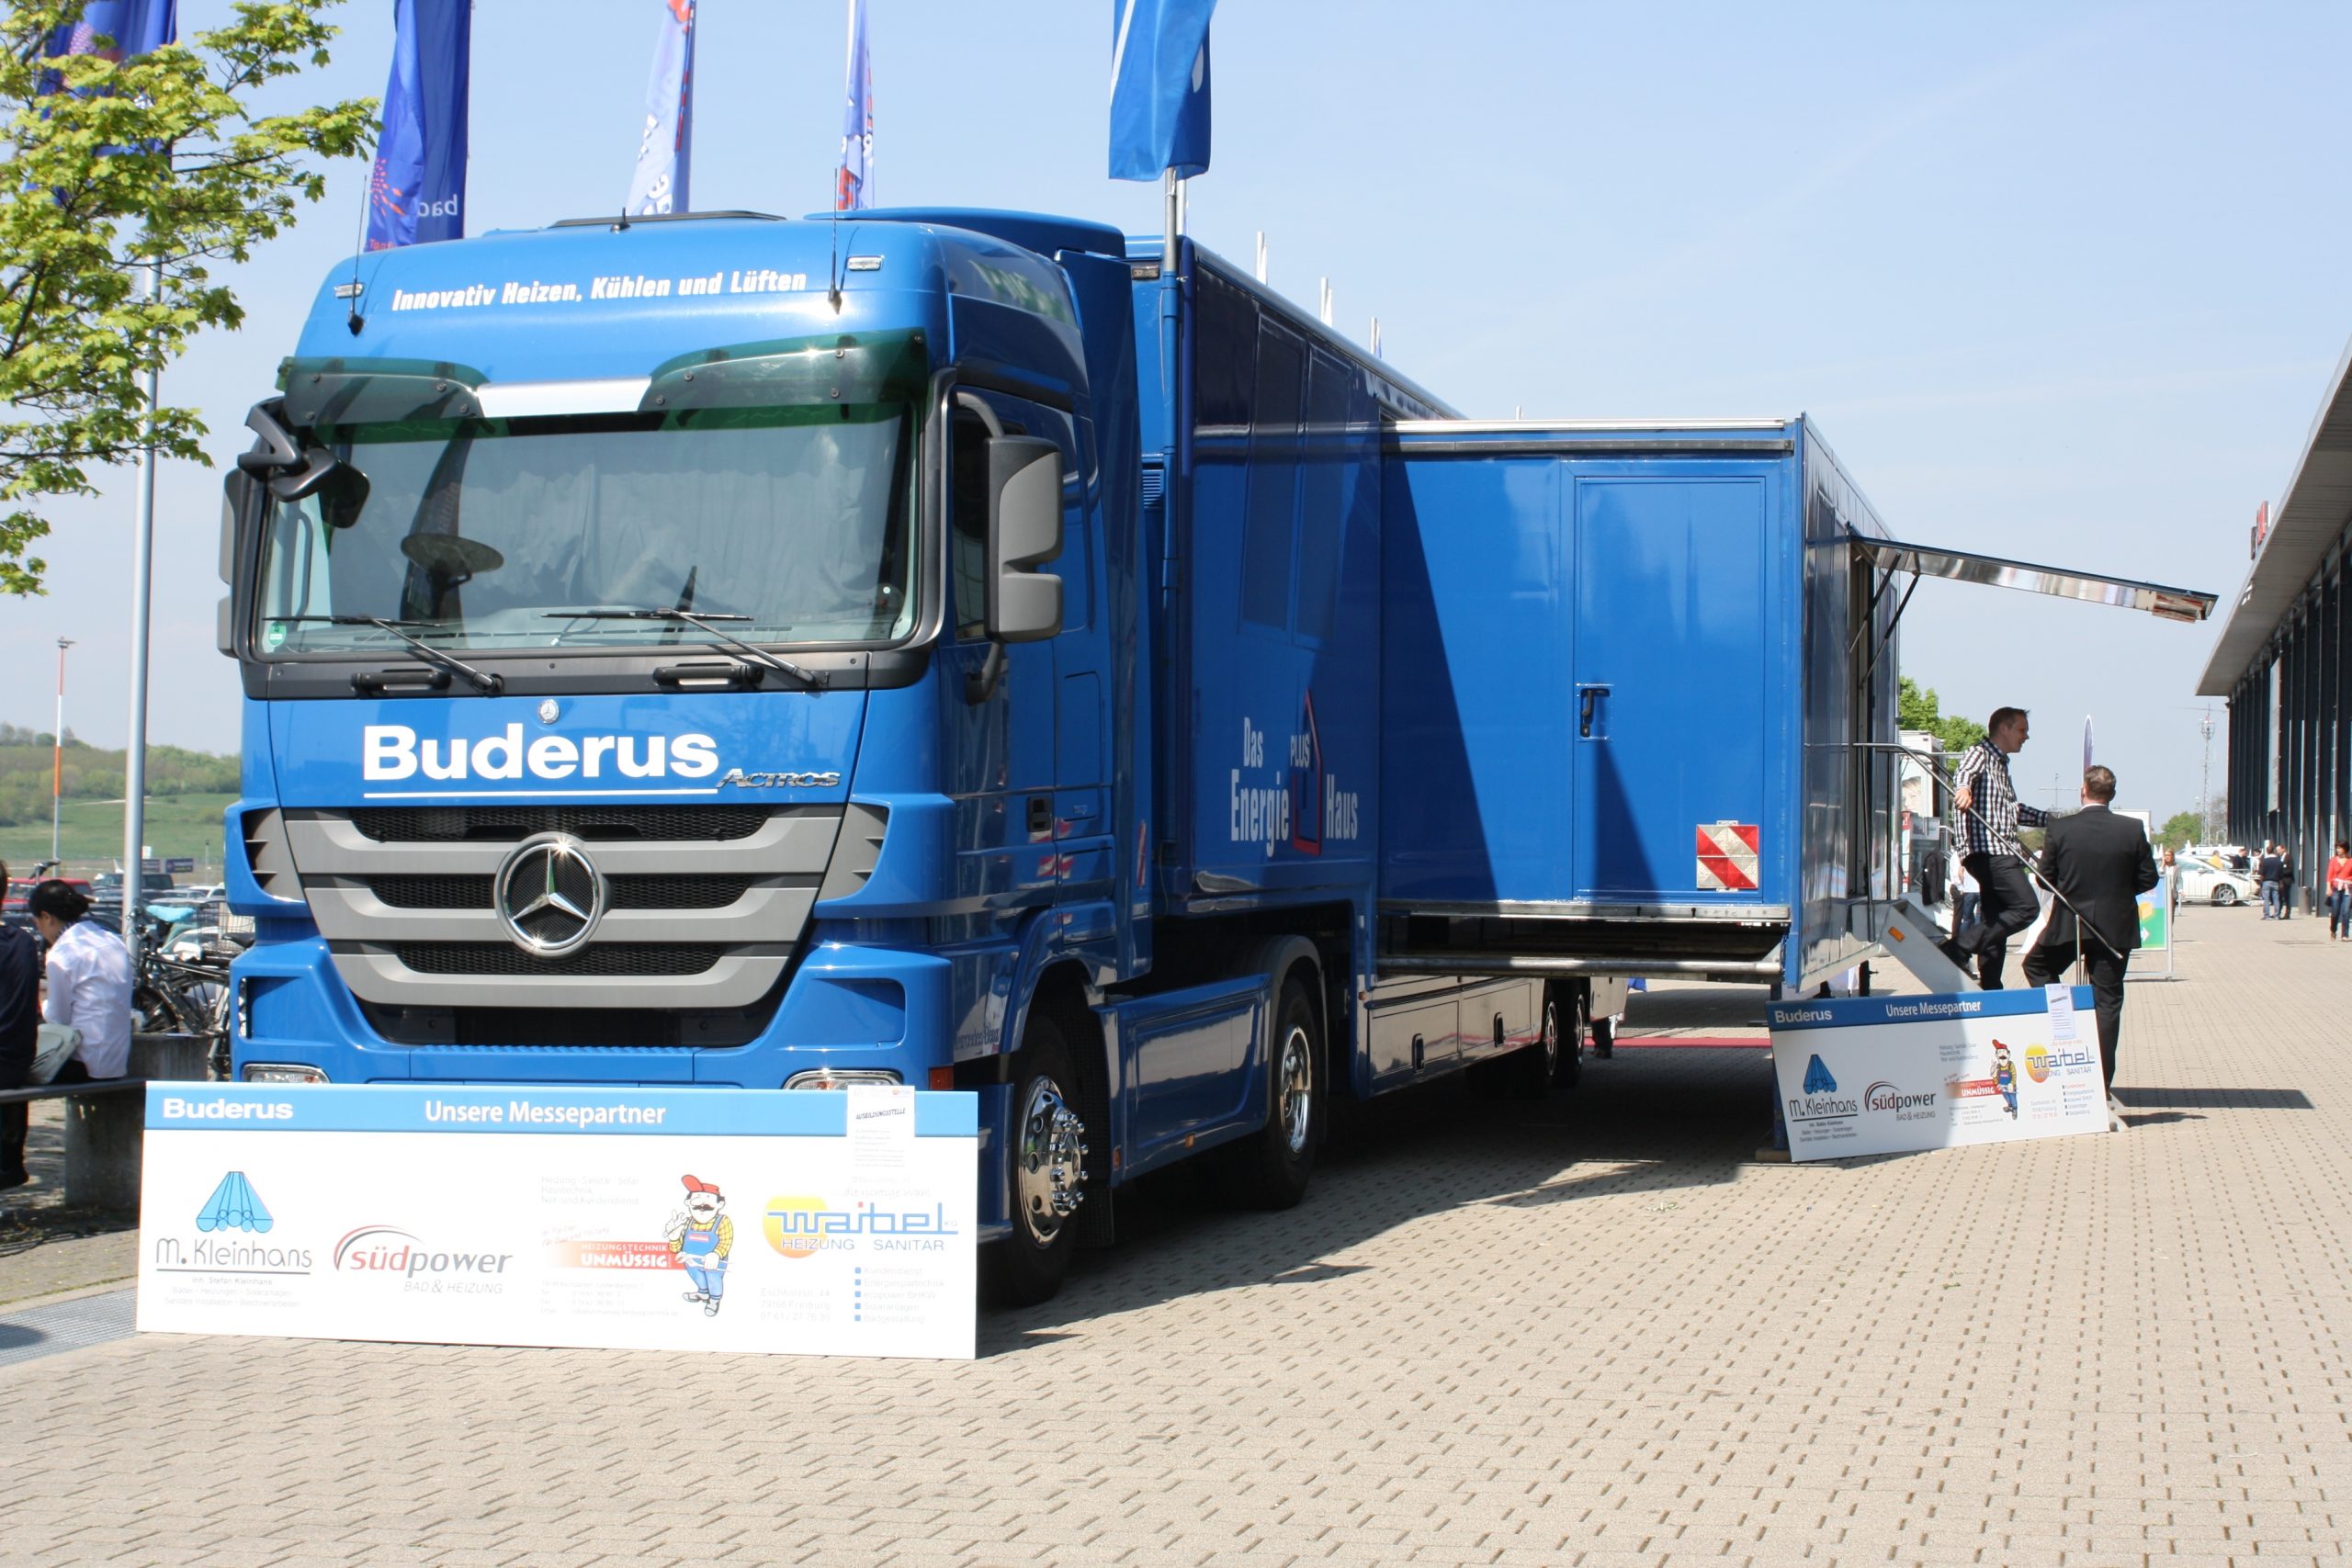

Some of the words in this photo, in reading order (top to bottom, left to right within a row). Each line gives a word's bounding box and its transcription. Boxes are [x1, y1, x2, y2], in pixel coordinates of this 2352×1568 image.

[392, 283, 495, 310] Innovativ
[501, 279, 582, 305] Heizen,
[591, 274, 670, 299] Kühlen
[678, 271, 723, 295] und
[730, 268, 807, 292] Lüften
[364, 722, 718, 780] Buderus
[1243, 716, 1263, 768] Das
[1290, 733, 1310, 768] PLUS
[1230, 769, 1289, 857] Energie
[1326, 774, 1358, 840] Haus
[1774, 1009, 1833, 1023] Buderus
[1885, 1003, 1917, 1017] Unsere
[1919, 1000, 1982, 1017] Messepartner
[1871, 1093, 1936, 1112] südpower
[1961, 1086, 1995, 1096] UNMÜSSIG
[163, 1099, 294, 1119] Buderus
[425, 1100, 503, 1122] Unsere
[508, 1101, 666, 1128] Messepartner
[1789, 1100, 1805, 1117] M.
[1805, 1097, 1858, 1114] Kleinhans
[1913, 1111, 1936, 1119] HEIZUNG
[767, 1201, 958, 1235] waibel
[156, 1238, 188, 1266] M.
[194, 1237, 313, 1269] Kleinhans
[581, 1243, 668, 1251] HEIZUNGSTECHNIK
[782, 1238, 855, 1251] HEIZUNG
[874, 1236, 944, 1251] SANITÄR
[350, 1245, 514, 1278] südpower
[581, 1251, 668, 1268] UNMÜSSIG
[403, 1280, 430, 1292] BAD
[431, 1279, 443, 1293] &
[447, 1281, 503, 1294] HEIZUNG
